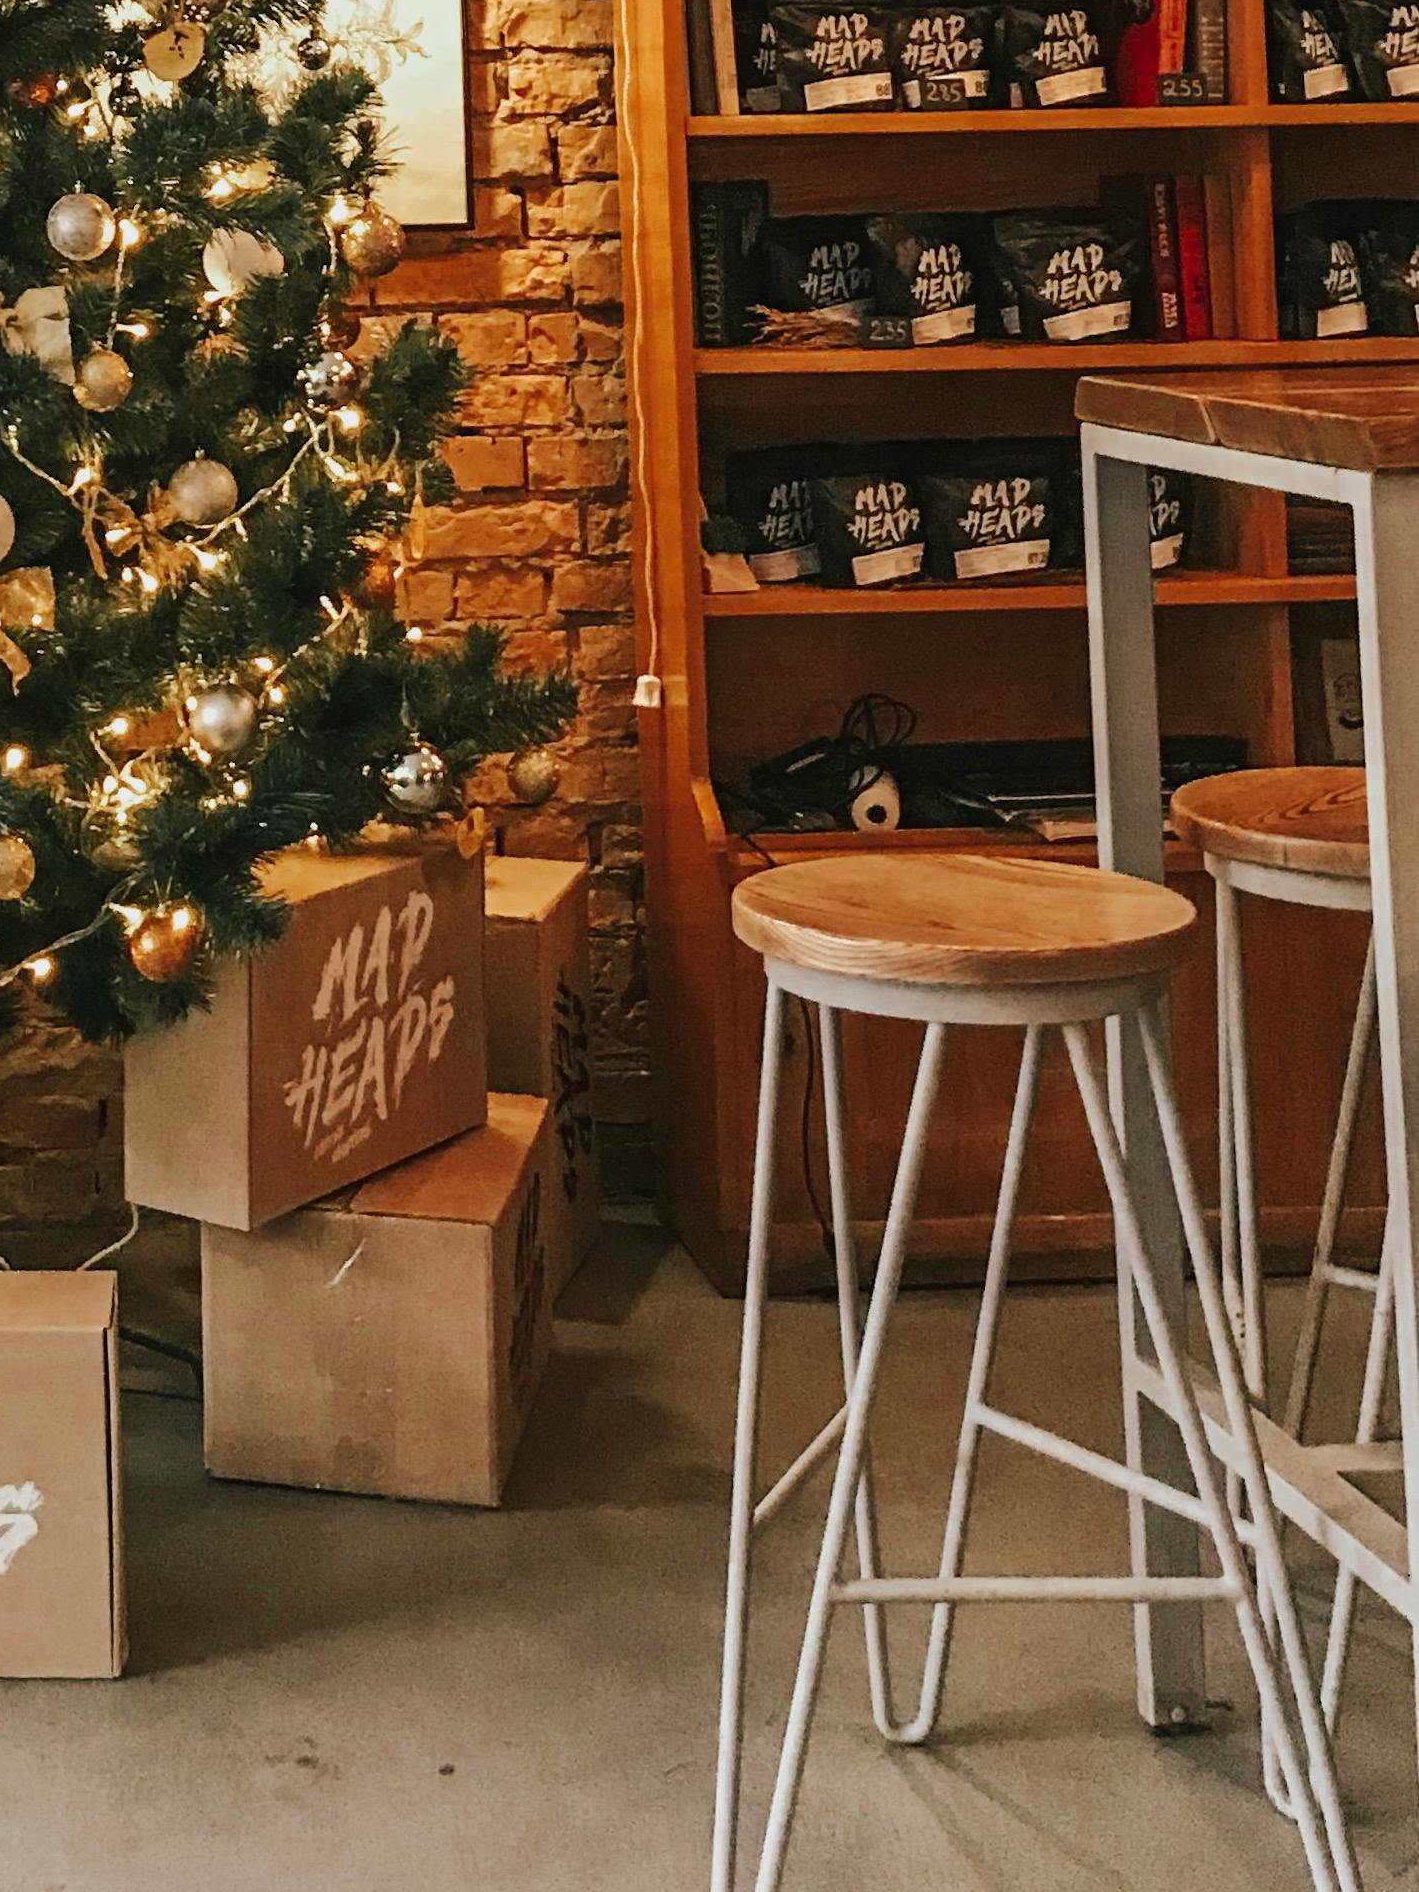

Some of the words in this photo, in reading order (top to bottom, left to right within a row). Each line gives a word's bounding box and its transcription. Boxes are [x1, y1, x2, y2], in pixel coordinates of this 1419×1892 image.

[817, 13, 868, 40] MAD
[908, 14, 965, 42] MAD
[1388, 4, 1419, 27] MA
[804, 38, 885, 70] HEADS
[900, 38, 984, 71] HEADS
[1301, 31, 1340, 61] HEA
[927, 82, 962, 103] 285
[1163, 79, 1204, 98] 255
[811, 240, 860, 271] MAD
[1047, 243, 1104, 274] MAD
[1039, 269, 1123, 305] HEADS
[869, 319, 906, 342] 235
[855, 481, 906, 512] MAD
[970, 477, 1031, 508] MAD
[846, 507, 921, 544] HEADS
[957, 504, 1046, 540] HEADS
[311, 889, 434, 1023] MAD
[282, 974, 455, 1150] HEADS
